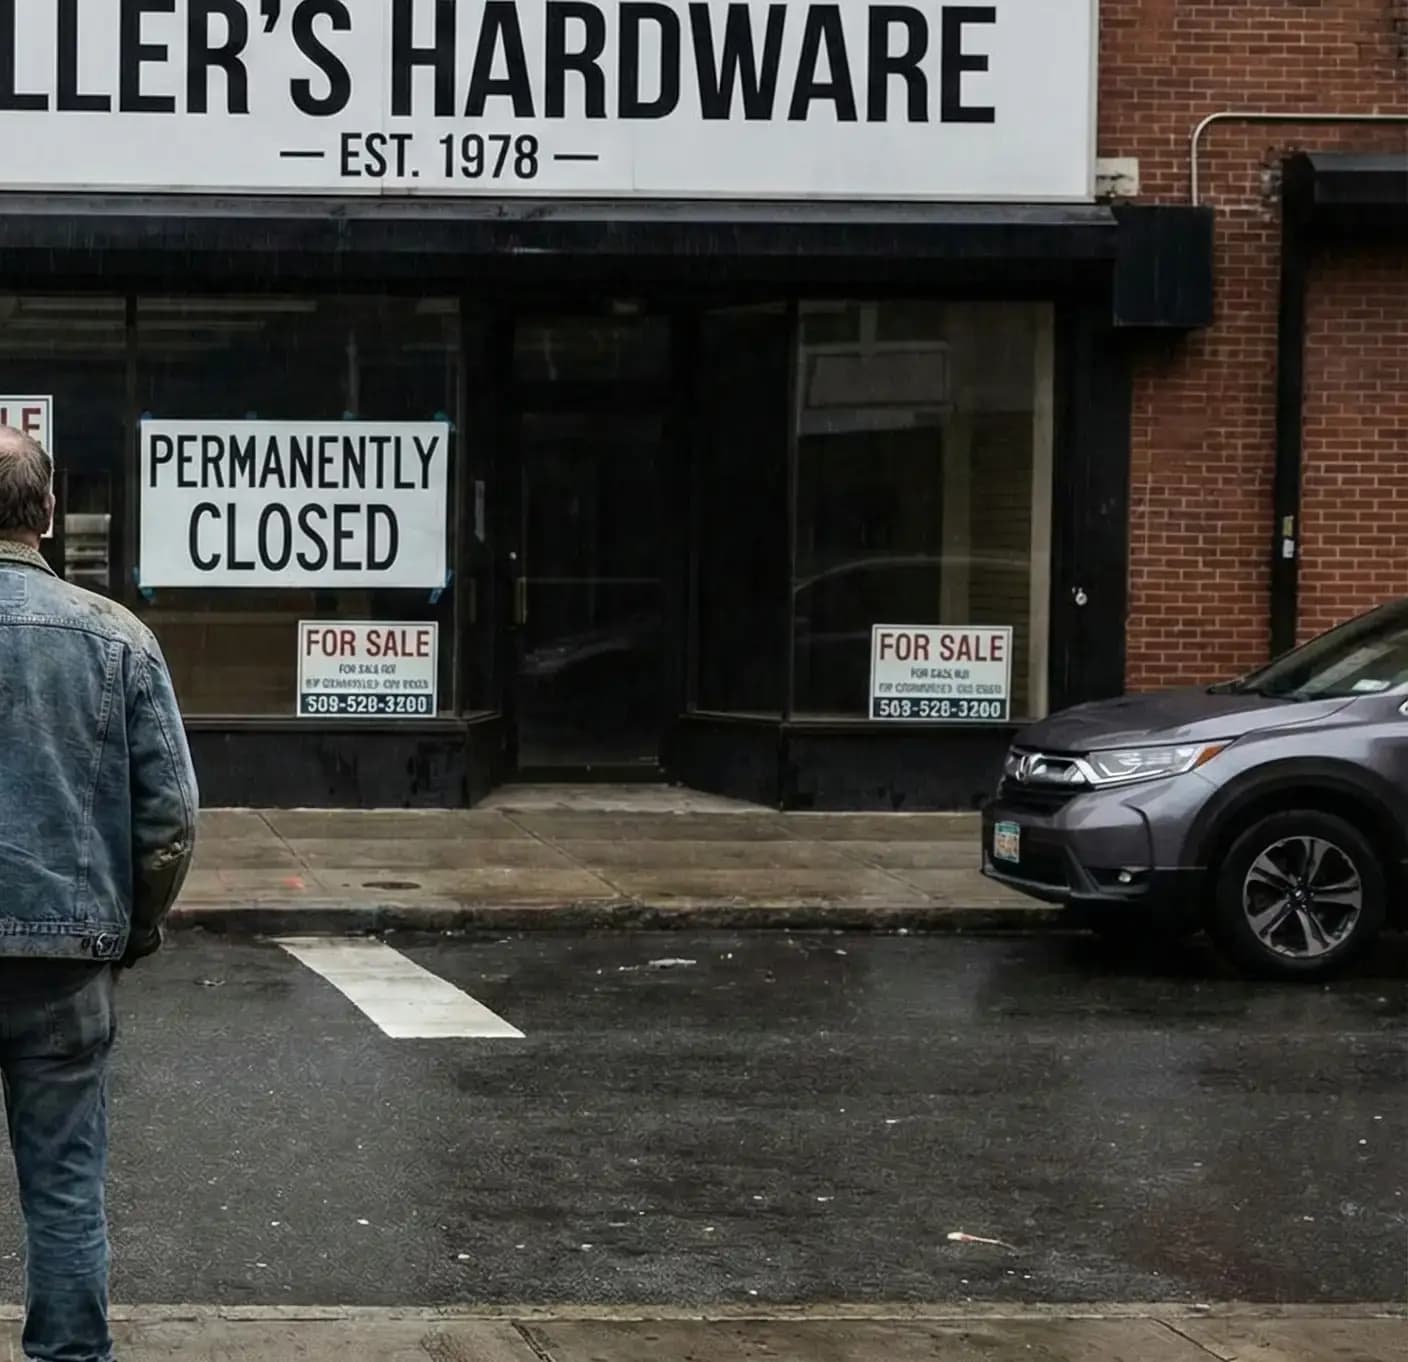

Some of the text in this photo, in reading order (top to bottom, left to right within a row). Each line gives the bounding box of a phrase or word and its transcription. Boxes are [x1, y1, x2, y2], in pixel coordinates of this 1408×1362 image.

[390, 0, 996, 124] HARDWARE
[339, 132, 539, 180] EST. 1978
[149, 434, 440, 490] PERMANENTLY
[188, 501, 400, 572] CLOSED
[305, 628, 430, 658] FOR SALE
[879, 632, 1005, 662] FOR SALE
